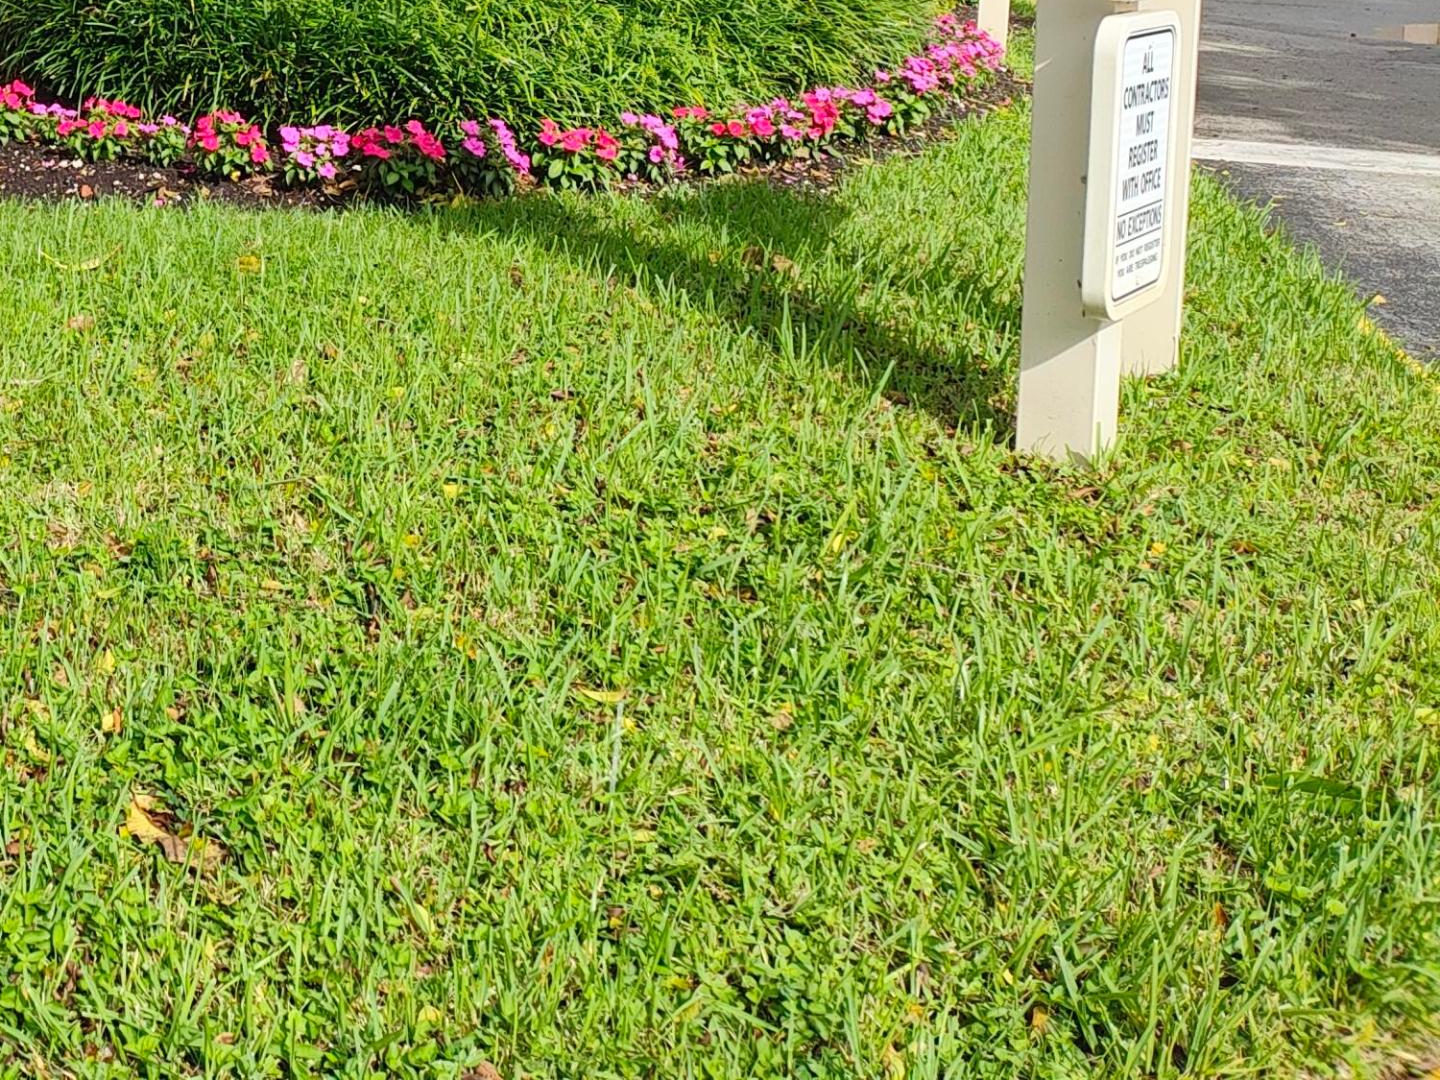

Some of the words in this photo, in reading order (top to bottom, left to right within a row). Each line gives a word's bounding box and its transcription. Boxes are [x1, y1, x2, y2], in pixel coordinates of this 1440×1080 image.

[1142, 50, 1154, 74] ALL
[1123, 77, 1169, 110] CONTRACTORS
[1136, 111, 1154, 136] MUST
[1128, 139, 1158, 169] REGISTER
[1122, 175, 1139, 201] WITH
[1140, 167, 1161, 194] OFFICE
[1117, 220, 1126, 240] NO
[1128, 205, 1162, 236] EXCEPTIONS
